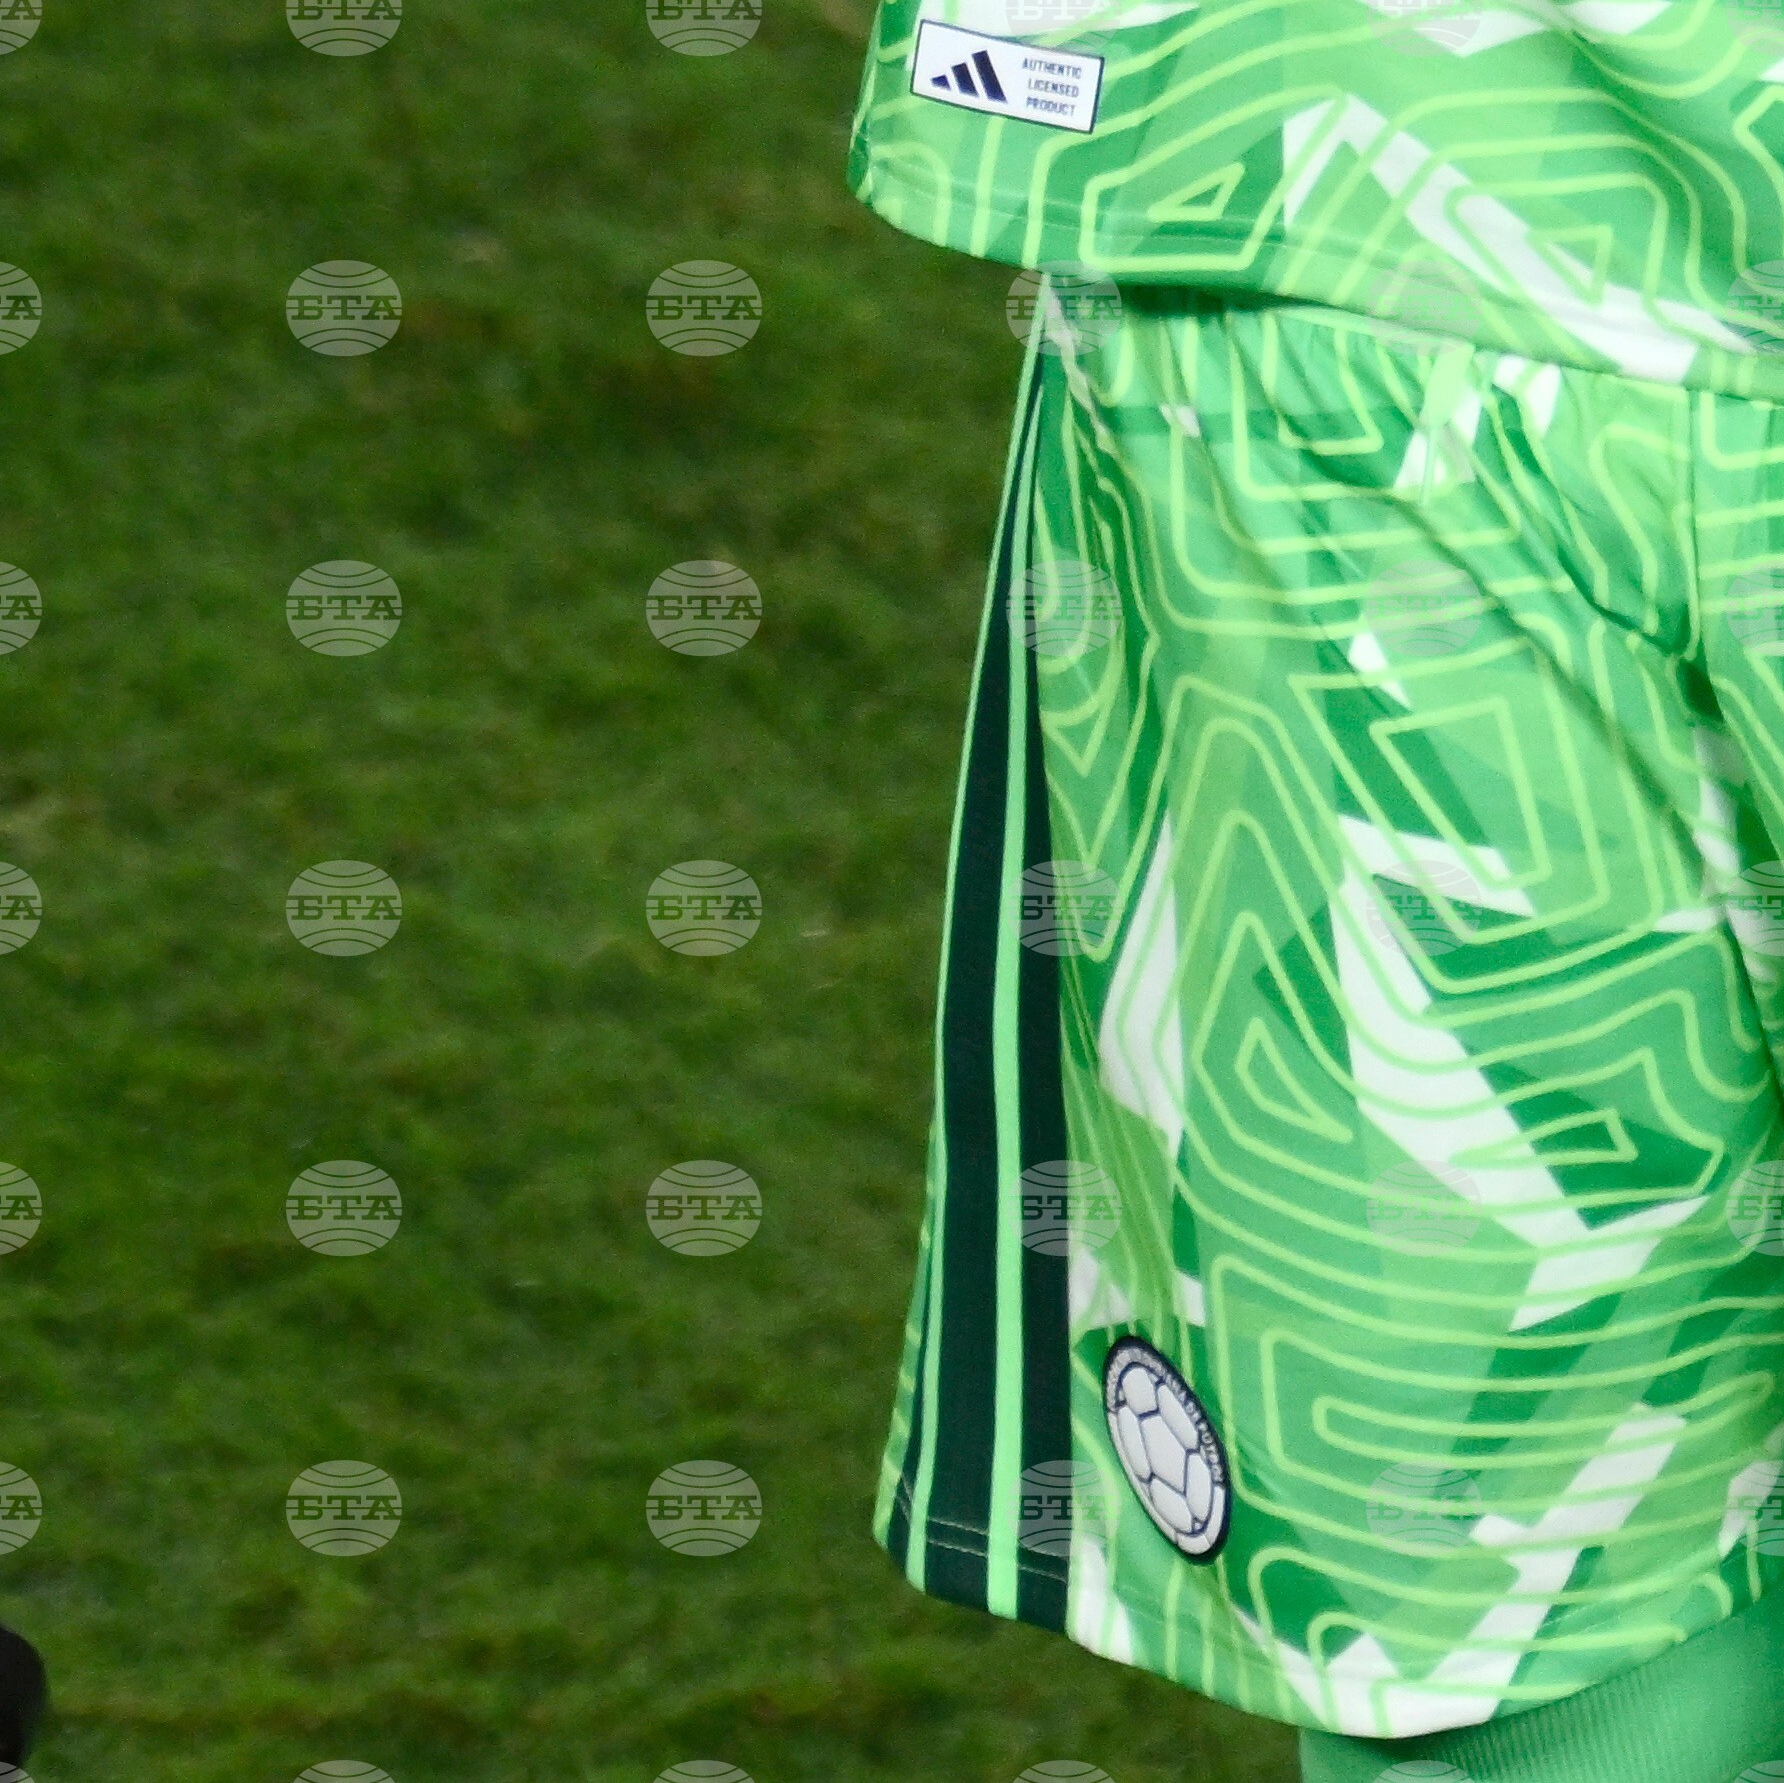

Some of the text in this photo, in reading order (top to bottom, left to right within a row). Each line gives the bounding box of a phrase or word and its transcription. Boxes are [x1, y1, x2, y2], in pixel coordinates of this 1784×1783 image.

[1022, 57, 1082, 79] AUTHENTIC
[1028, 78, 1079, 98] LICENSED
[1026, 96, 1075, 116] PRODUCT
